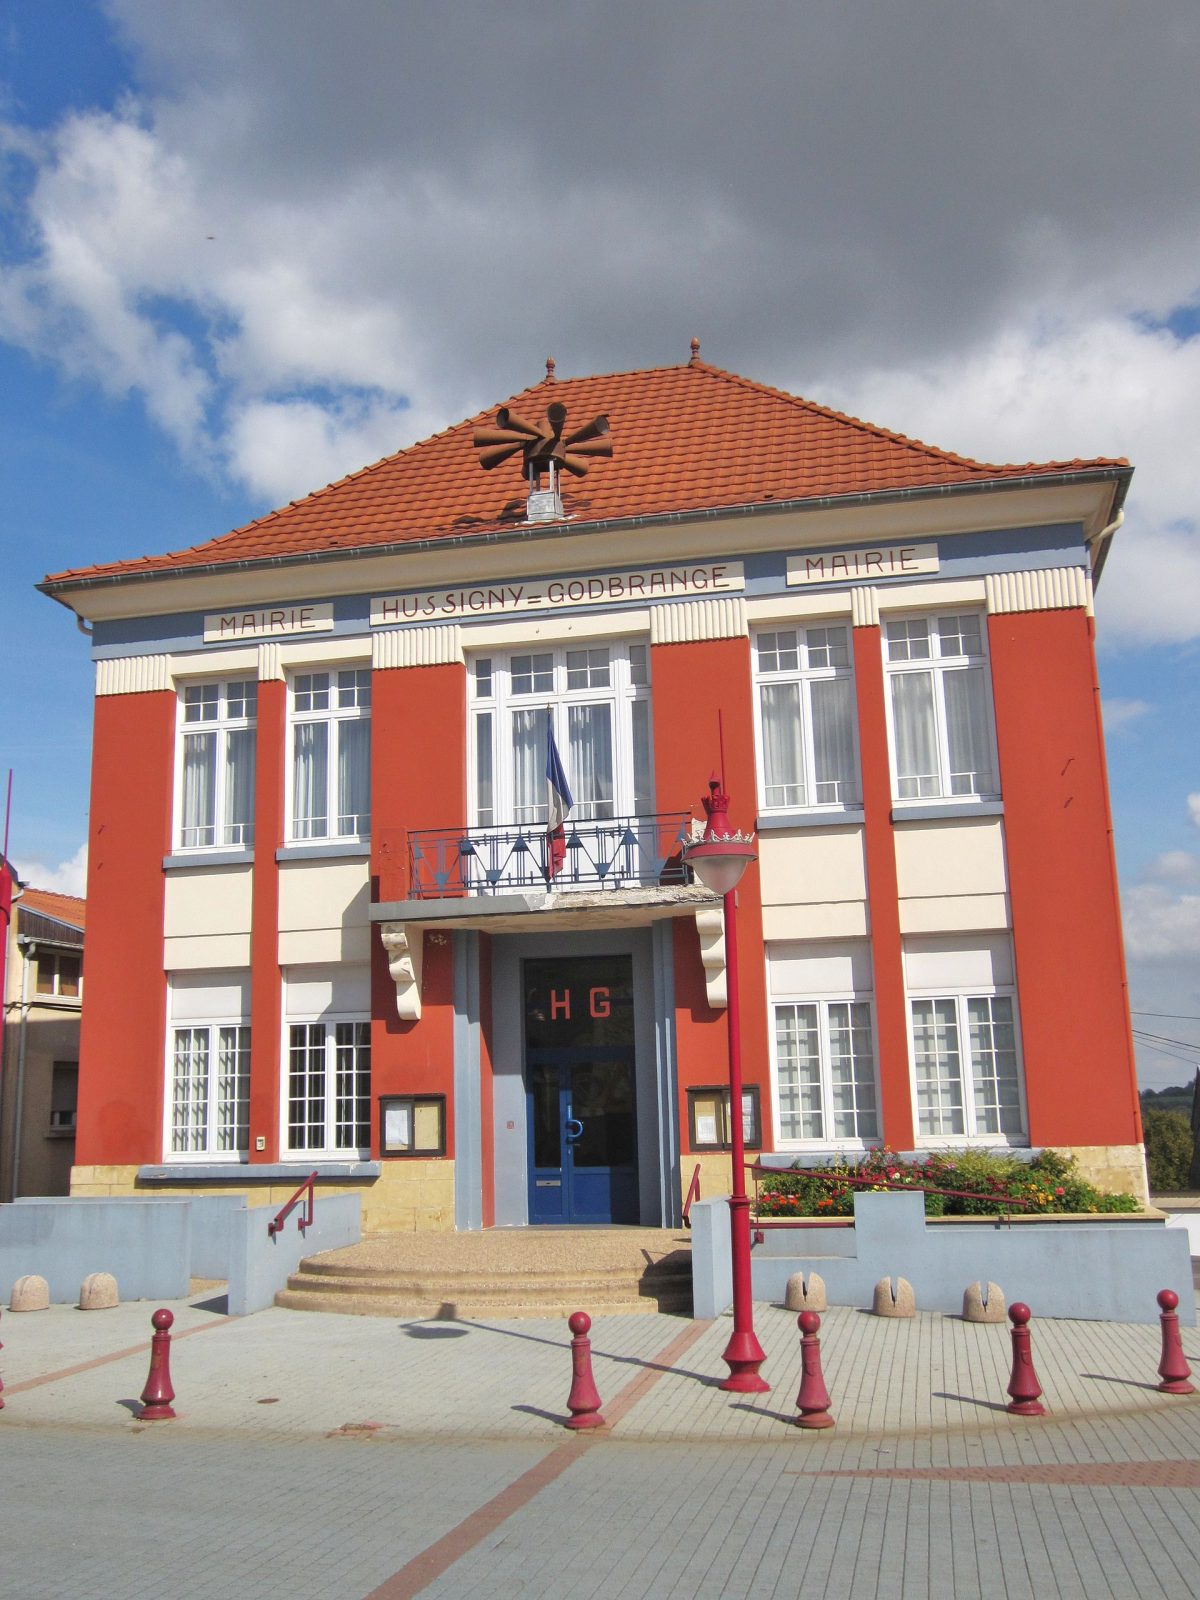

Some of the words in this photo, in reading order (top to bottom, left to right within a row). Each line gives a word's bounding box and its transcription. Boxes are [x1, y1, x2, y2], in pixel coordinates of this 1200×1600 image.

[805, 548, 919, 580] MAIRIE
[220, 607, 316, 637] MAIRIE
[551, 989, 570, 1020] H
[589, 986, 611, 1018] G
